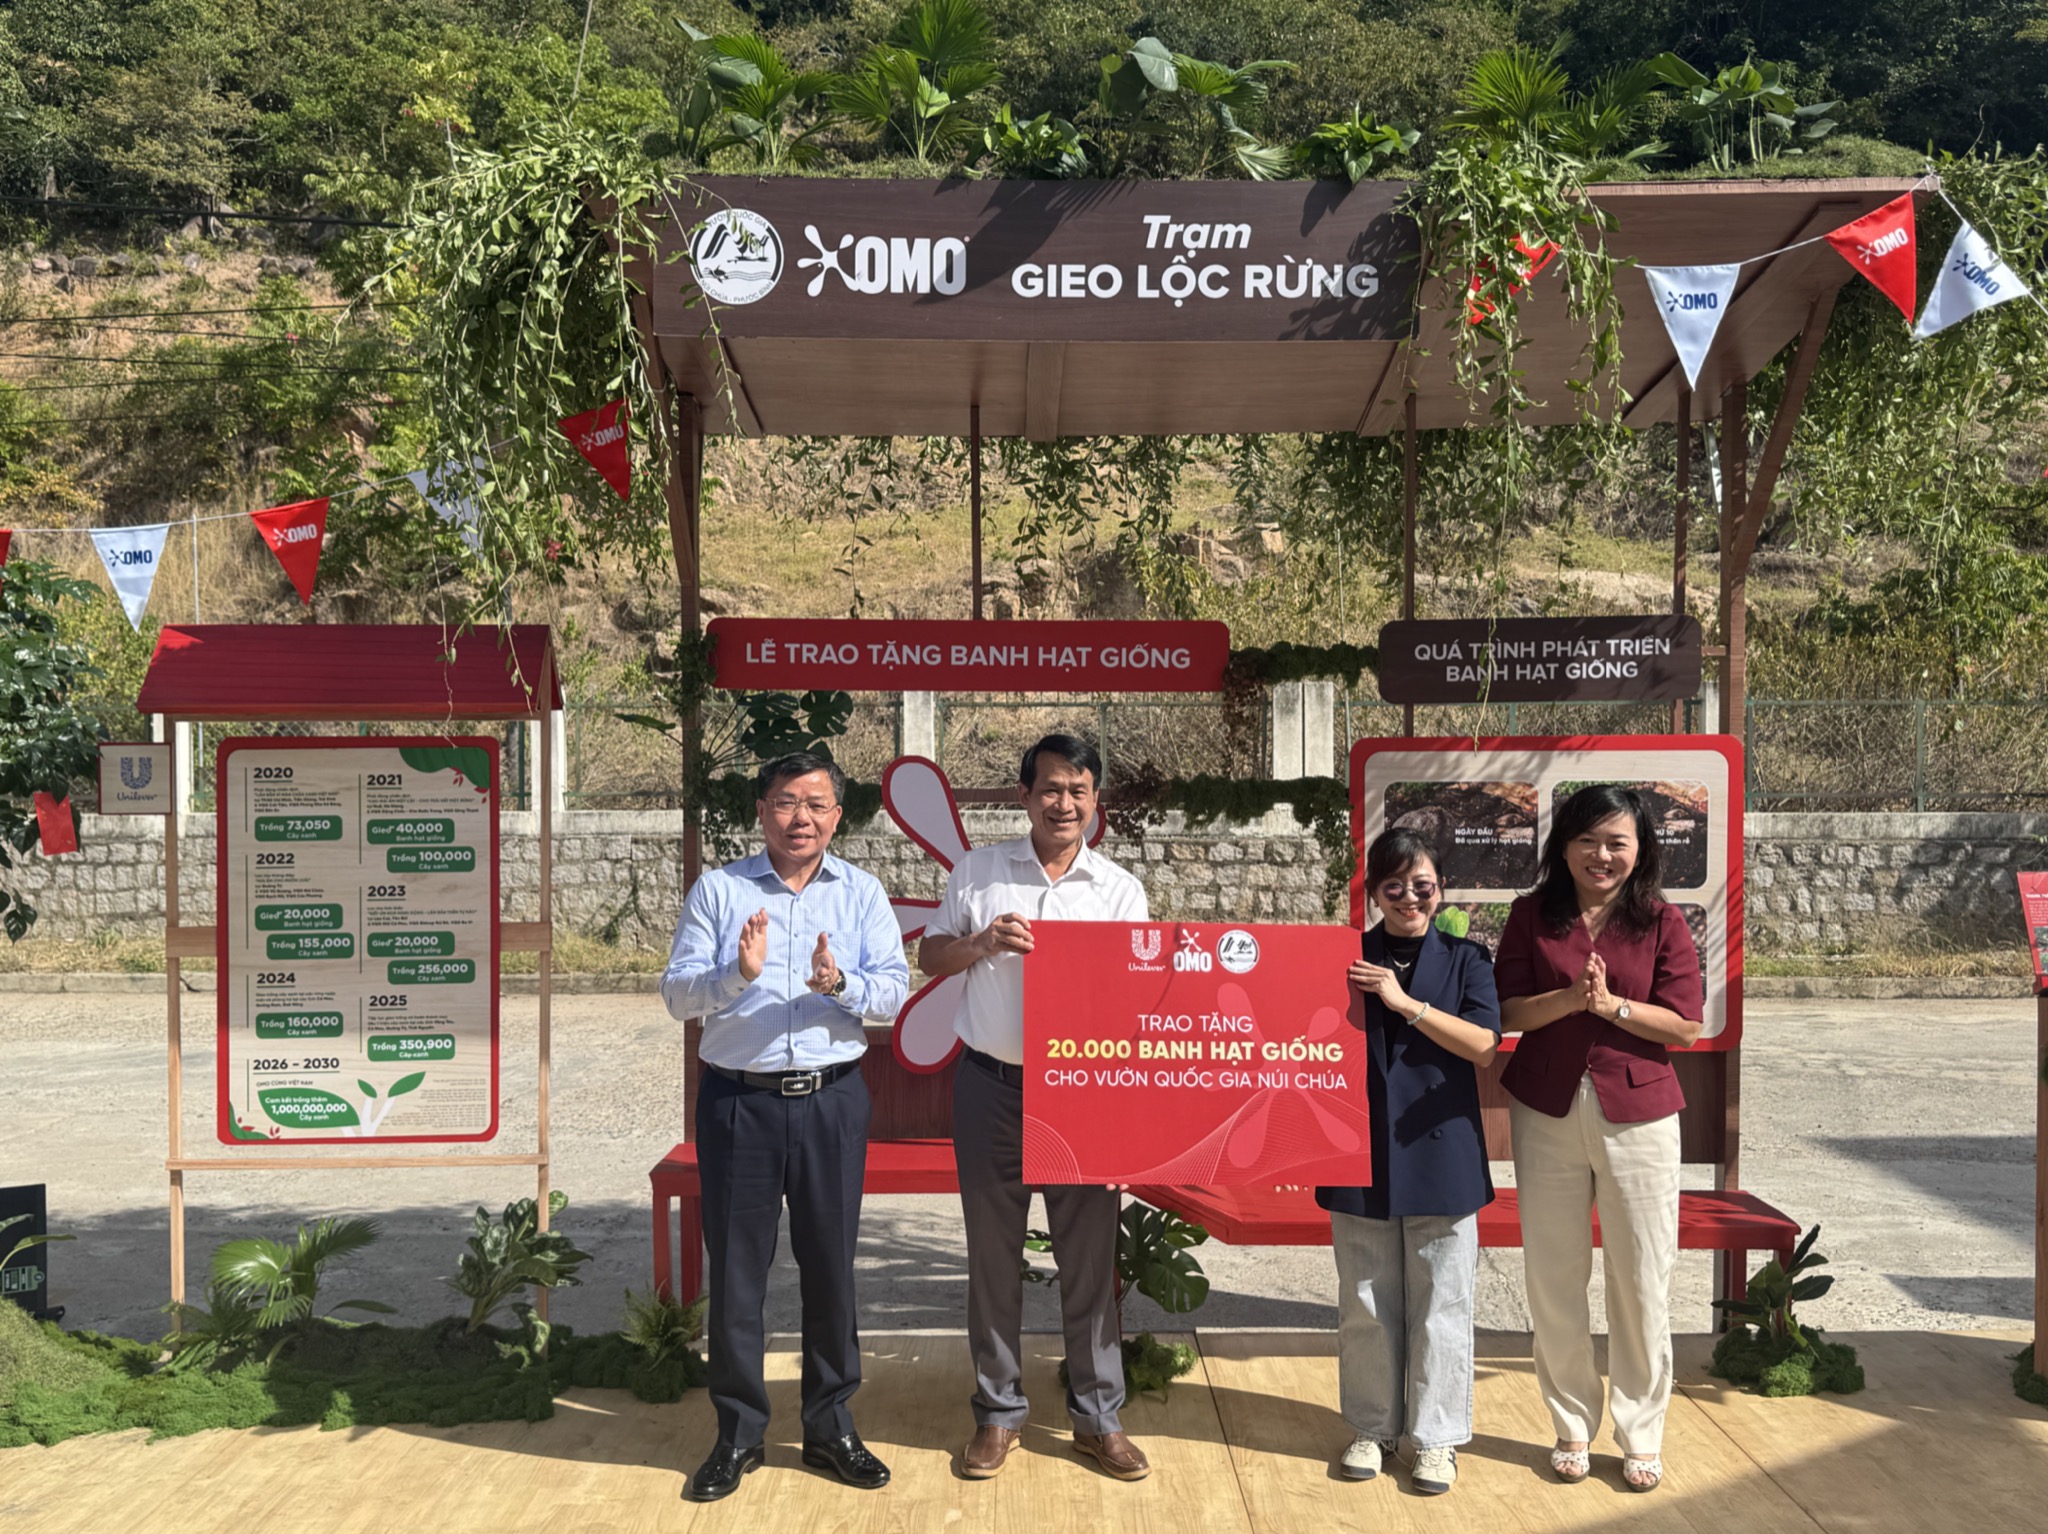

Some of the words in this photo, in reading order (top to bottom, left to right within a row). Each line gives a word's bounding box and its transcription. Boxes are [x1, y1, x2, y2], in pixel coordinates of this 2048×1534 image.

[754, 216, 767, 228] GIA
[1142, 214, 1252, 258] Trạm
[1873, 227, 1909, 257] OMO
[855, 236, 966, 295] OMO
[1011, 263, 1123, 299] GIEO
[1137, 254, 1230, 308] LỘC
[1243, 254, 1379, 299] RỪNG
[1966, 265, 2000, 295] OMO
[1683, 292, 1718, 310] OMO
[595, 425, 624, 446] OMO
[288, 523, 318, 543] OMO
[124, 549, 153, 565] OMO
[1414, 638, 1462, 662] QUÁ
[1468, 637, 1535, 661] TRÌNH
[1542, 636, 1600, 658] PHÁT
[1606, 635, 1671, 656] TRIỂN
[745, 638, 777, 664] LỄ
[785, 641, 860, 665] TRAO
[867, 640, 943, 671] TẶNG
[951, 644, 1028, 667] BANH
[1038, 646, 1092, 673] HẠT
[1100, 641, 1191, 669] GIỐNG
[1446, 664, 1509, 683] BANH
[1515, 663, 1559, 685] HẠT
[1565, 657, 1638, 680] GIỐNG
[253, 767, 294, 779] 2020
[366, 774, 402, 786] 2021
[117, 791, 157, 801] Unilever
[286, 819, 331, 832] 73,050
[396, 823, 443, 835] 40,000
[1455, 827, 1476, 836] NGÀY
[1477, 826, 1493, 836] ĐẦU
[287, 832, 299, 840] Cây
[414, 835, 425, 843] hạt
[426, 834, 446, 843] giống
[1455, 836, 1466, 844] Đã
[256, 853, 295, 865] 2022
[418, 850, 472, 863] 100,000
[367, 885, 406, 897] 2023
[284, 908, 330, 920] 20,000
[314, 920, 334, 928] giống
[298, 937, 351, 949] 155,000
[394, 936, 439, 948] 20,000
[298, 949, 311, 957] Cây
[423, 946, 442, 955] giống
[1128, 962, 1165, 972] Unilever
[1173, 951, 1212, 972] OMO
[417, 963, 468, 976] 256,000
[256, 972, 296, 984] 2024
[417, 974, 430, 983] Cây
[369, 995, 407, 1007] 2025
[287, 1016, 339, 1028] 160,000
[1137, 1014, 1193, 1032] TRAO
[1198, 1011, 1254, 1037] TẶNG
[399, 1038, 452, 1051] 350,900
[1046, 1038, 1132, 1059] 20.000
[1139, 1040, 1202, 1059] BANH
[1210, 1041, 1255, 1066] HẠT
[1261, 1035, 1344, 1062] GIỐNG
[399, 1051, 412, 1059] Cây
[253, 1058, 288, 1070] 2026
[303, 1057, 340, 1069] 2030
[1044, 1069, 1089, 1087] CHO
[1094, 1066, 1148, 1087] VƯỜN
[1154, 1065, 1214, 1088] QUỐC
[1218, 1071, 1253, 1088] GIA
[1258, 1068, 1289, 1088] NÚI
[1294, 1069, 1348, 1090] CHÚA
[281, 1096, 293, 1104] kết
[311, 1095, 328, 1103] thêm
[271, 1103, 348, 1115] 1,000,000,000
[299, 1113, 312, 1122] Cây
[313, 1113, 330, 1121] xanh
